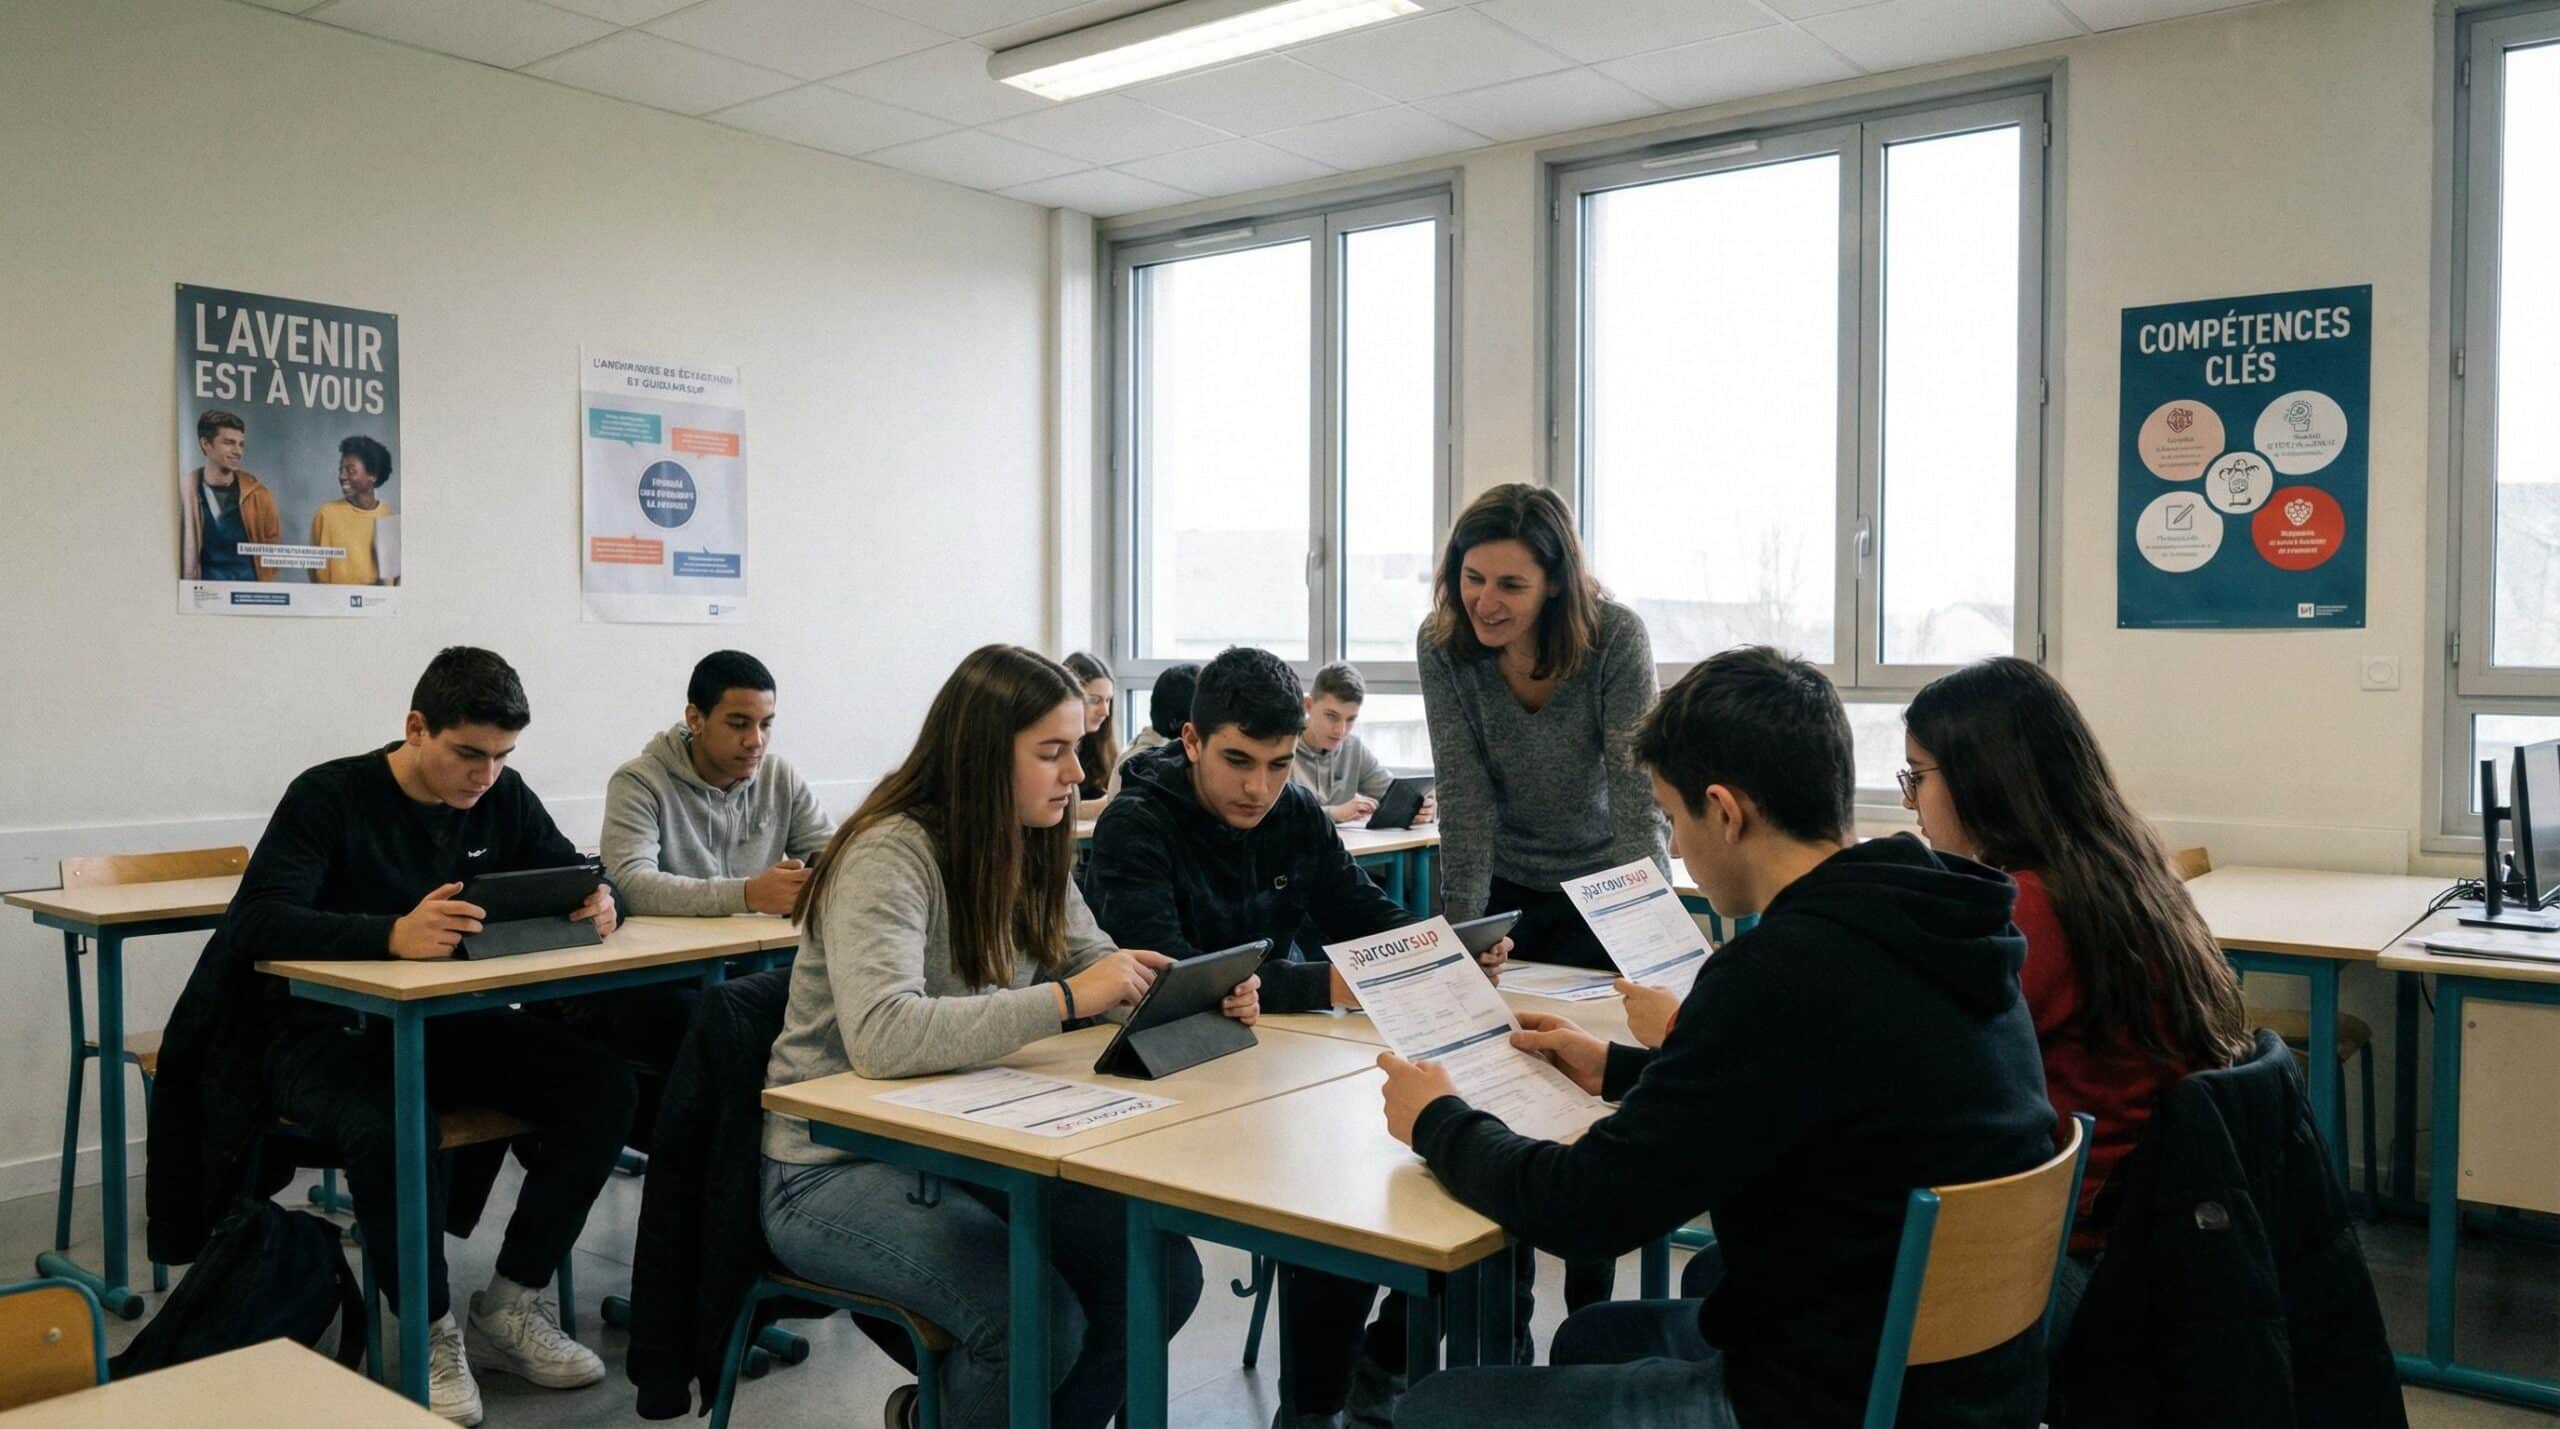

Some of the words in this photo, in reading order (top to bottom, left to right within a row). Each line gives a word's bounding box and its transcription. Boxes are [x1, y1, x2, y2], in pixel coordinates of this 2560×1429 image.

[196, 302, 384, 373] L'AVENIR
[2139, 306, 2351, 354] COMPÉTENCES
[196, 360, 257, 402] EST
[266, 359, 290, 406] À
[298, 371, 384, 415] VOUS
[2205, 346, 2277, 386] CLÉS
[1582, 869, 1648, 900] parcoursup
[1352, 930, 1439, 967] parcoursup
